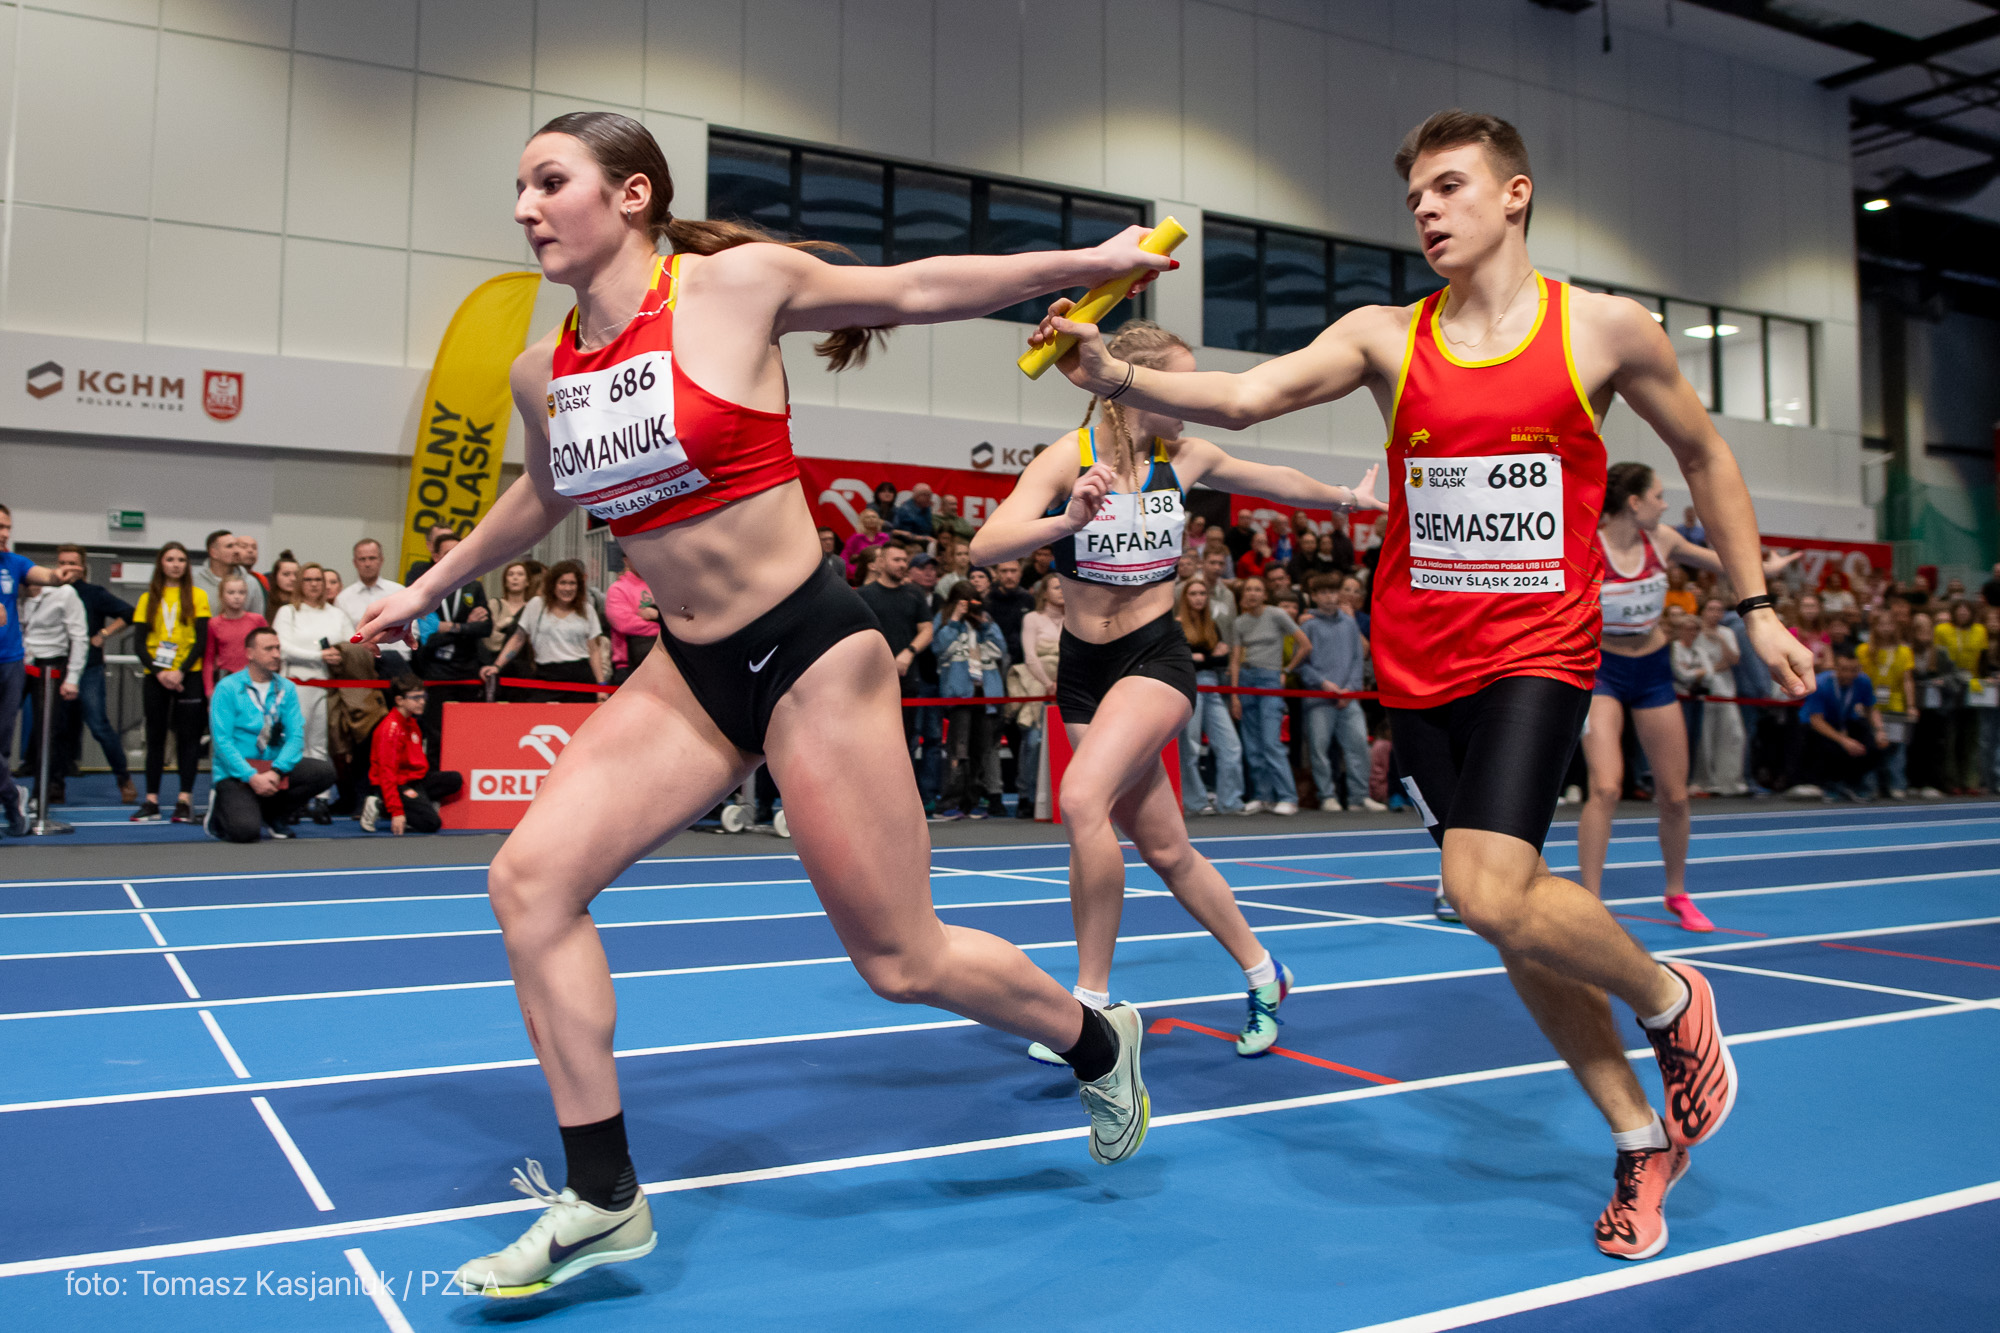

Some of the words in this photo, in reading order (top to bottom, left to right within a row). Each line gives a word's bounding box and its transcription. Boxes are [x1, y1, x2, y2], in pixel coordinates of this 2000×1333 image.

[78, 369, 185, 399] KGHM
[610, 362, 656, 403] 686
[552, 414, 673, 479] ROMANIUK
[1002, 447, 1033, 467] KG
[412, 400, 462, 535] DOLNY
[1428, 467, 1468, 477] DOLNY
[1487, 461, 1548, 490] 688
[1428, 475, 1467, 489] ŚLĄSK
[615, 493, 656, 514] ŚLĄSK
[655, 480, 690, 501] 2024
[1139, 495, 1174, 515] 138
[1414, 511, 1556, 543] SIEMASZKO
[1454, 562, 1500, 570] Mistrzostwa
[1501, 562, 1525, 570] Polski
[1525, 562, 1540, 570] U18
[1545, 560, 1560, 569] U20
[1087, 571, 1119, 582] DOLNY
[1422, 573, 1463, 586] DOLNY
[1466, 574, 1510, 589] ŚLĄSK
[1513, 576, 1549, 587] 2024
[478, 775, 549, 795] ORL
